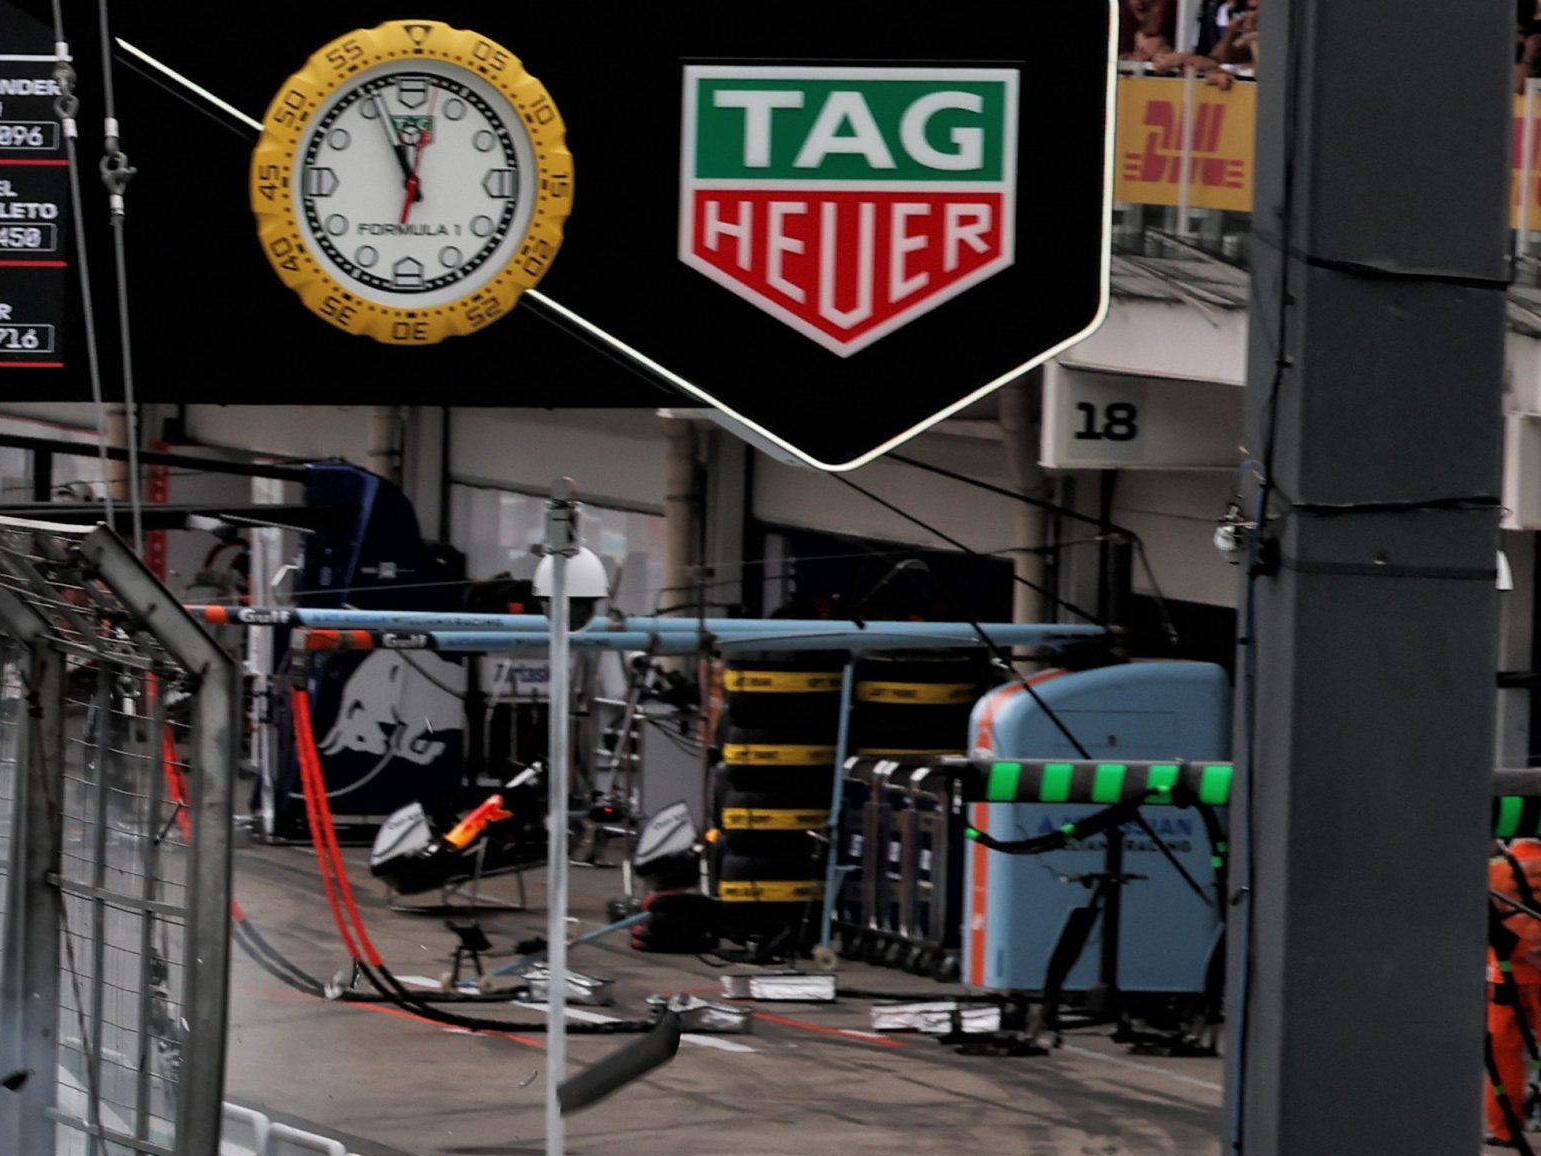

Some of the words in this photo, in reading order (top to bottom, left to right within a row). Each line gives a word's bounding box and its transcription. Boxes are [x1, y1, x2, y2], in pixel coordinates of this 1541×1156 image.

[325, 39, 364, 70] 55
[471, 41, 509, 72] 05
[274, 90, 308, 127] 50
[530, 95, 555, 127] 10
[713, 90, 985, 171] TAG
[258, 165, 280, 202] 45
[548, 171, 570, 199] 15
[357, 223, 447, 237] FORMULA
[270, 236, 301, 273] 40
[704, 201, 992, 330] HEUER
[319, 295, 358, 327] 35
[464, 297, 504, 328] 25
[392, 322, 428, 341] 30
[1075, 402, 1138, 442] 18
